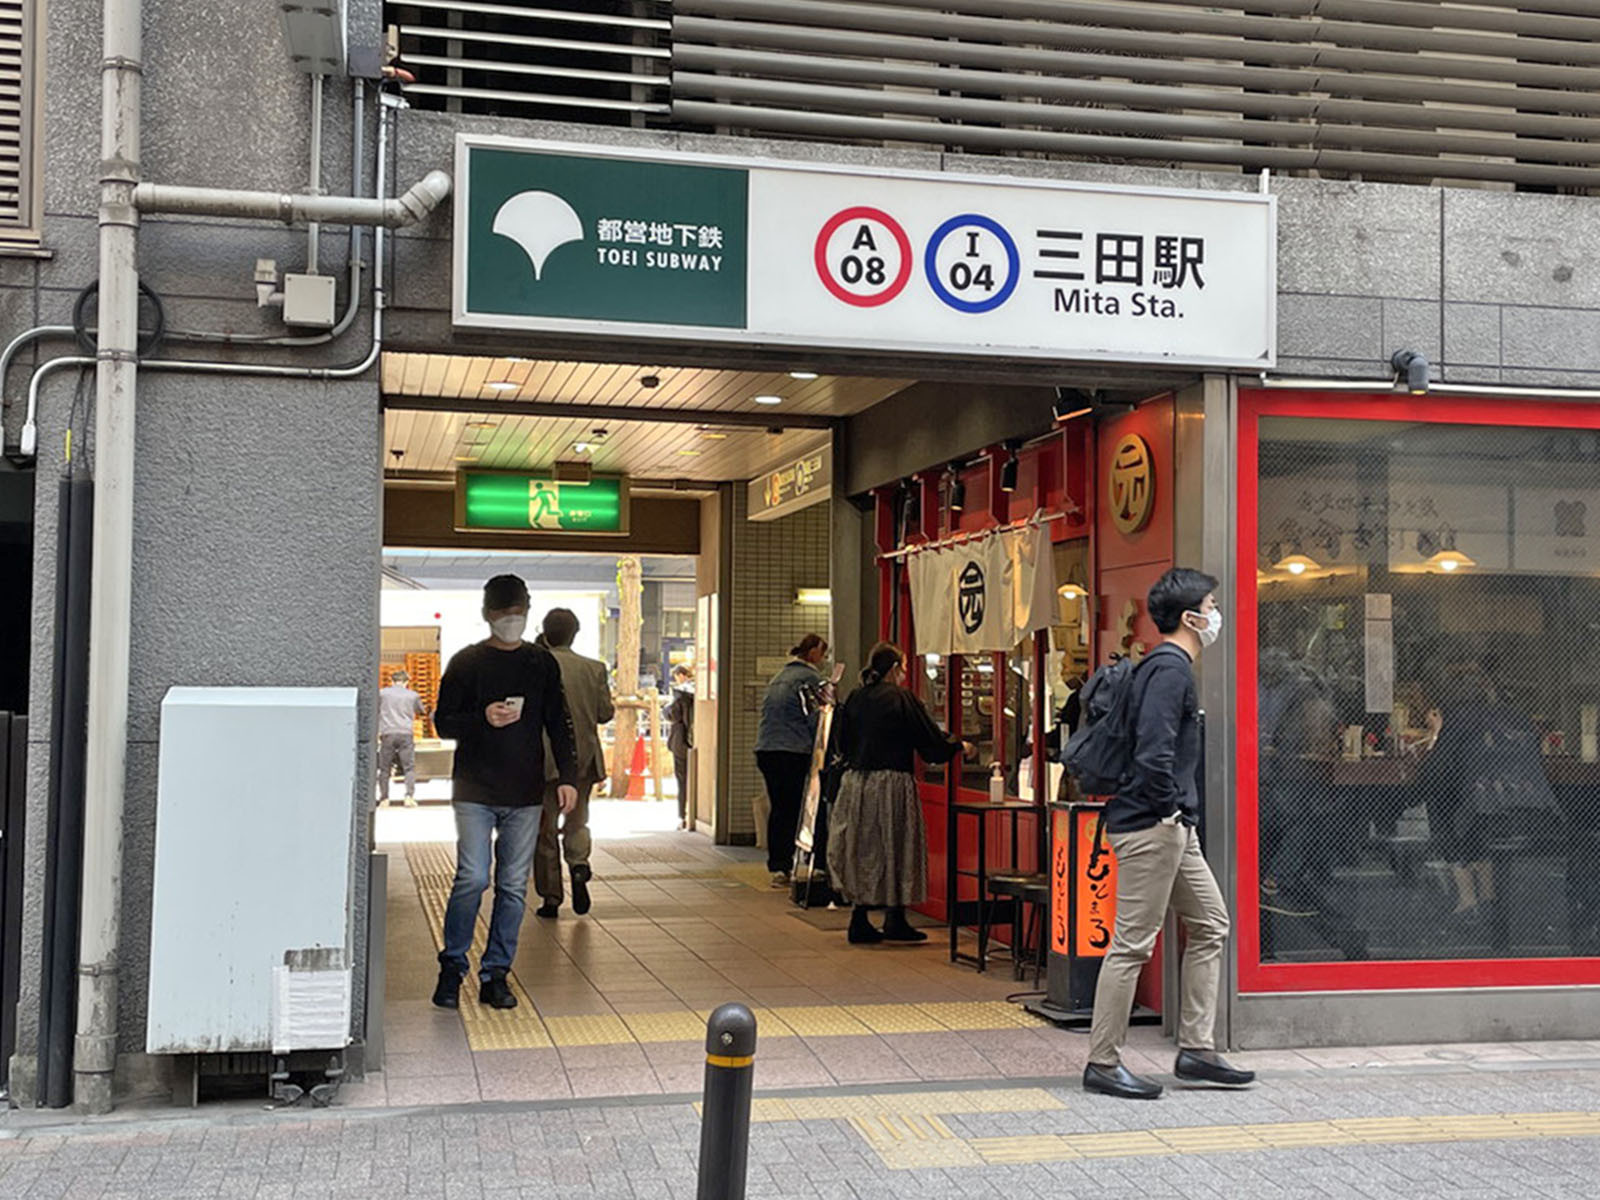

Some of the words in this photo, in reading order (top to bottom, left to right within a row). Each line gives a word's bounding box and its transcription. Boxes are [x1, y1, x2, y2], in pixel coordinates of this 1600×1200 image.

[597, 218, 723, 249] 都営地下鉄
[852, 224, 877, 251] A
[965, 231, 980, 258] I
[597, 247, 638, 266] TOEI
[645, 250, 723, 272] SUBWAY
[840, 254, 887, 286] 08
[1033, 229, 1206, 291] 三田駅
[949, 261, 995, 292] 04
[1054, 287, 1120, 316] Mita
[1131, 291, 1185, 319] Sta.
